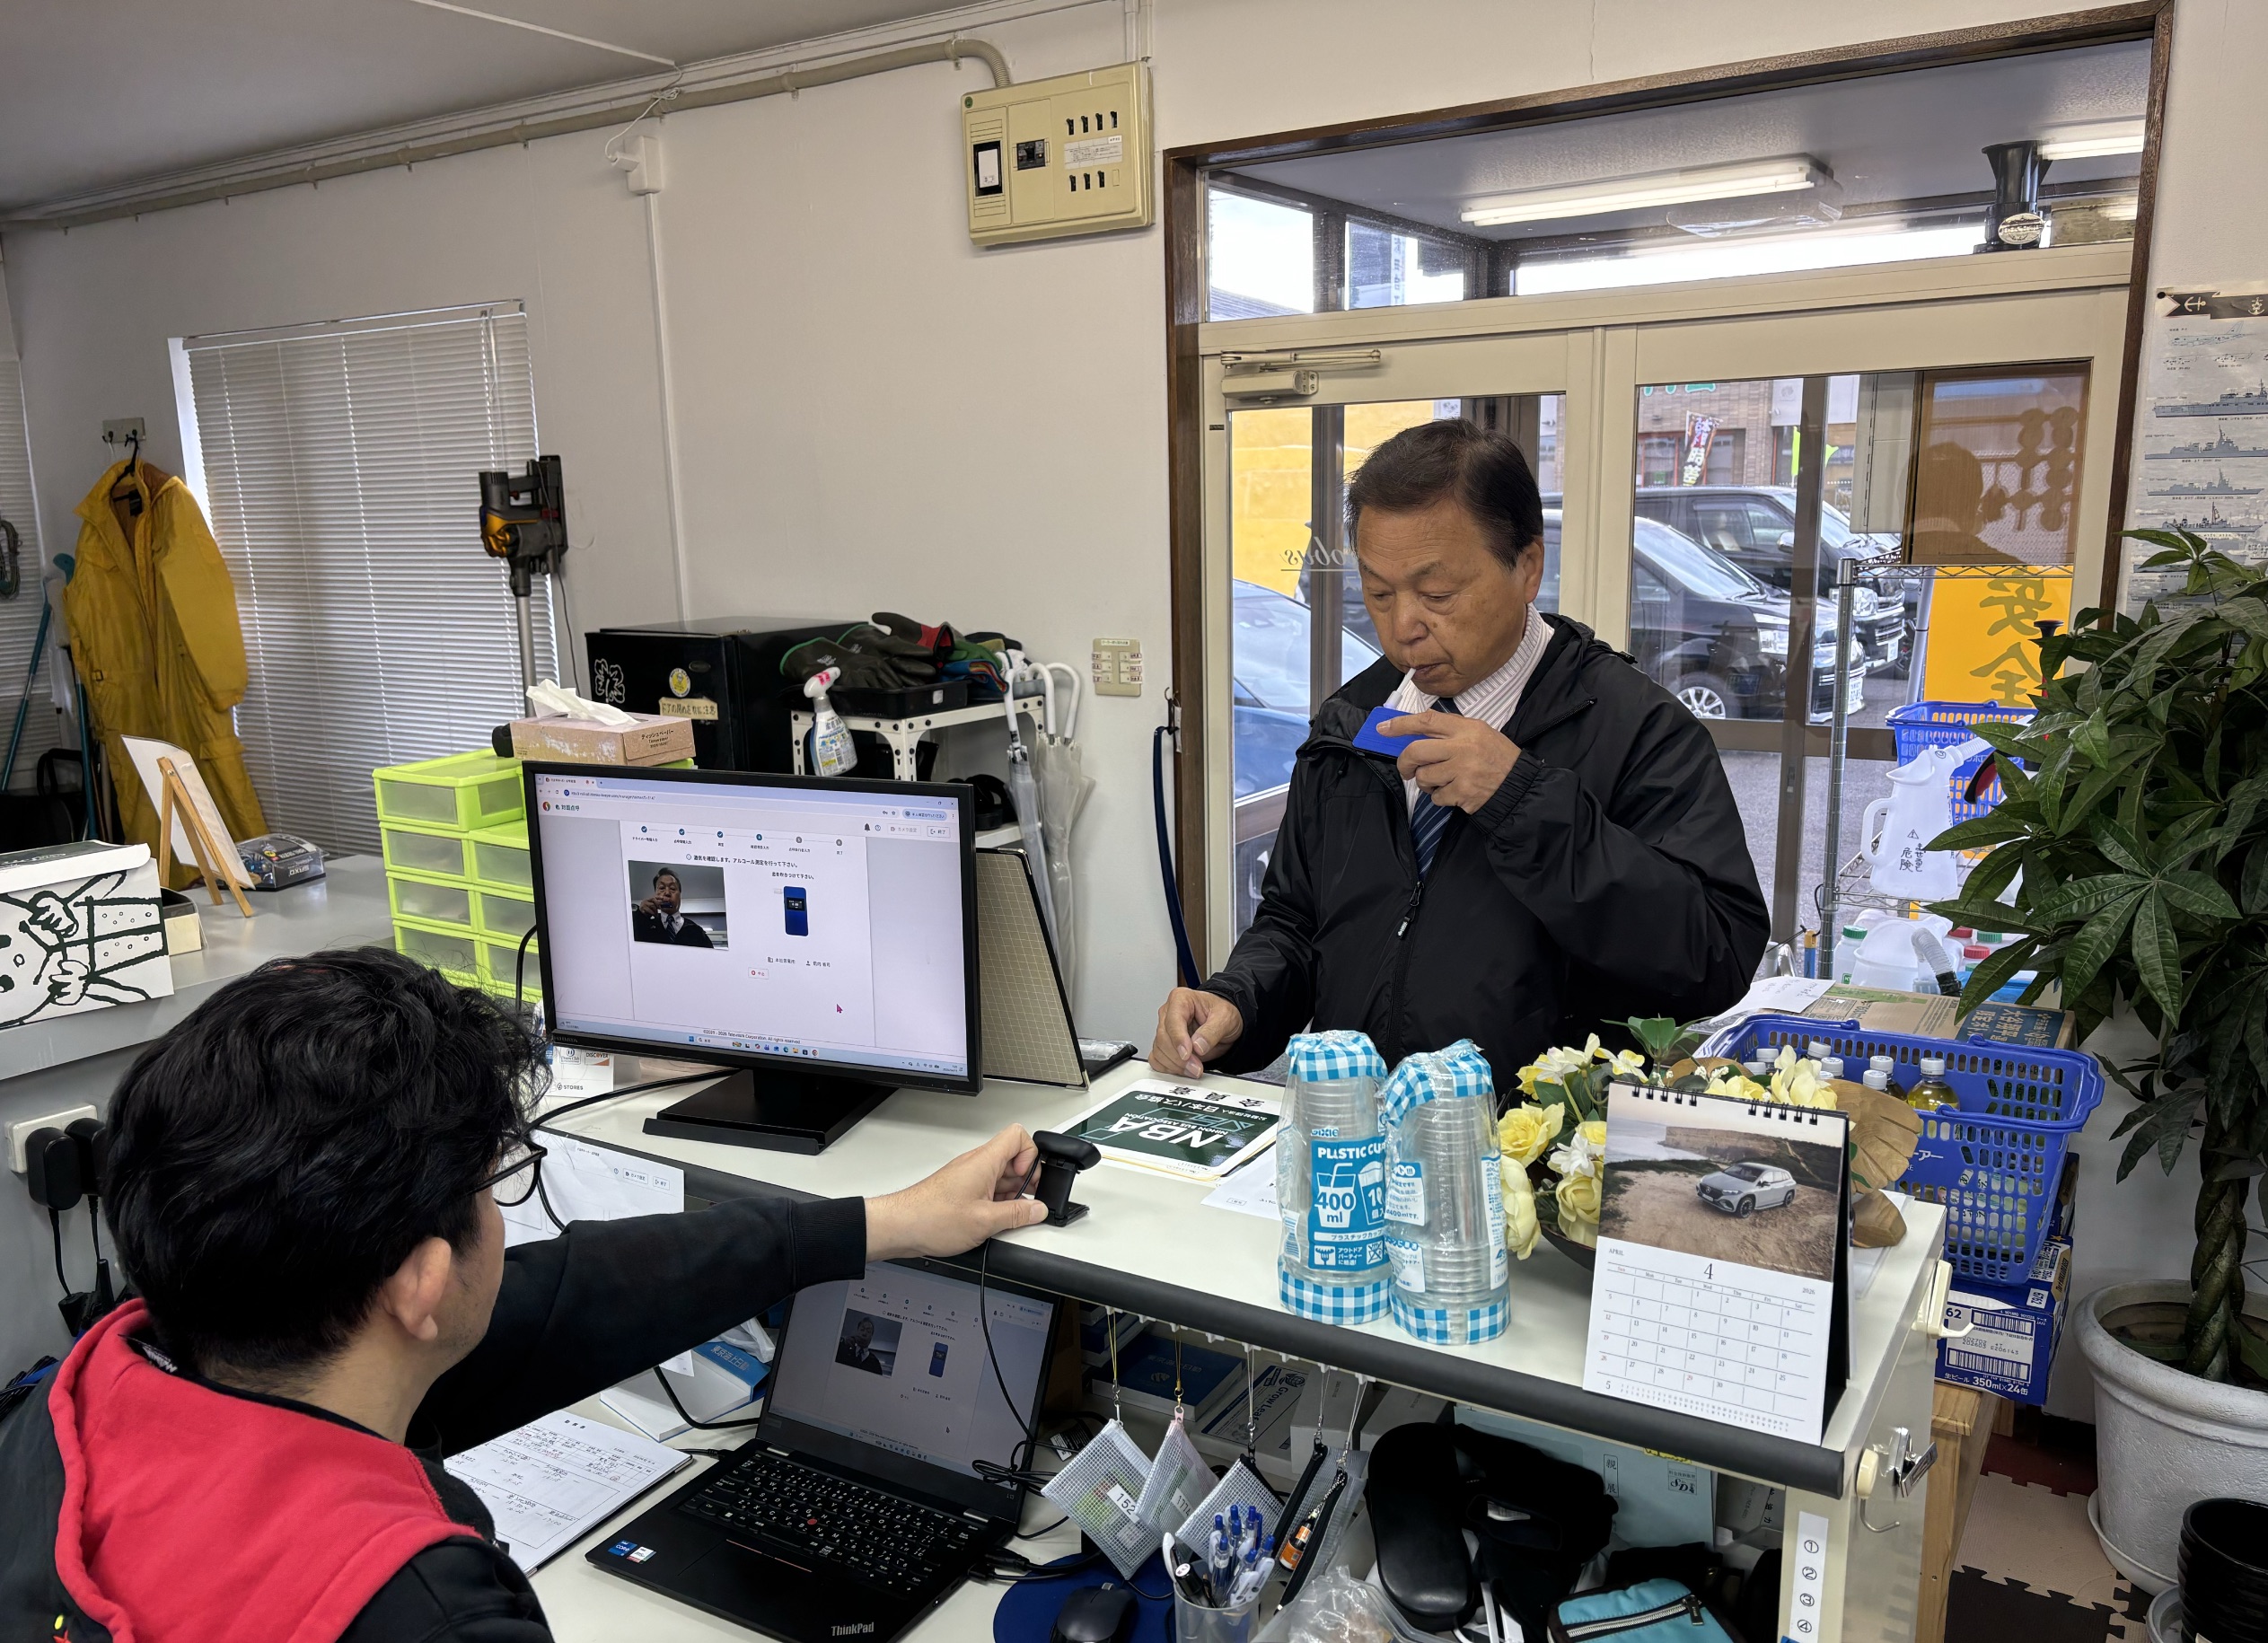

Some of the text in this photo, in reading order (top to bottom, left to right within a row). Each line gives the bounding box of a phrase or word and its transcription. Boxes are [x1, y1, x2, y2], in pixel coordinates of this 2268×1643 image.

[1899, 847, 1914, 873] 危険
[1135, 1094, 1219, 1112] 日本バス協会
[1124, 1112, 1228, 1135] NIHON BUS ASSOCIATION
[1108, 1117, 1225, 1148] NBA
[1317, 1147, 1367, 1159] PLASTIC
[1316, 1192, 1355, 1211] 400
[1326, 1211, 1342, 1223] ml
[1331, 1229, 1383, 1241] プラスチックカップ
[1703, 1262, 1713, 1279] 4
[2031, 1291, 2044, 1306] 6762
[1604, 1380, 1612, 1389] 5
[1945, 1373, 1970, 1384] 生ビール
[1270, 1386, 1289, 1407] Grow
[1606, 1459, 1617, 1494] 親展
[1116, 1493, 1136, 1516] 152
[831, 1621, 875, 1637] ThinkPad
